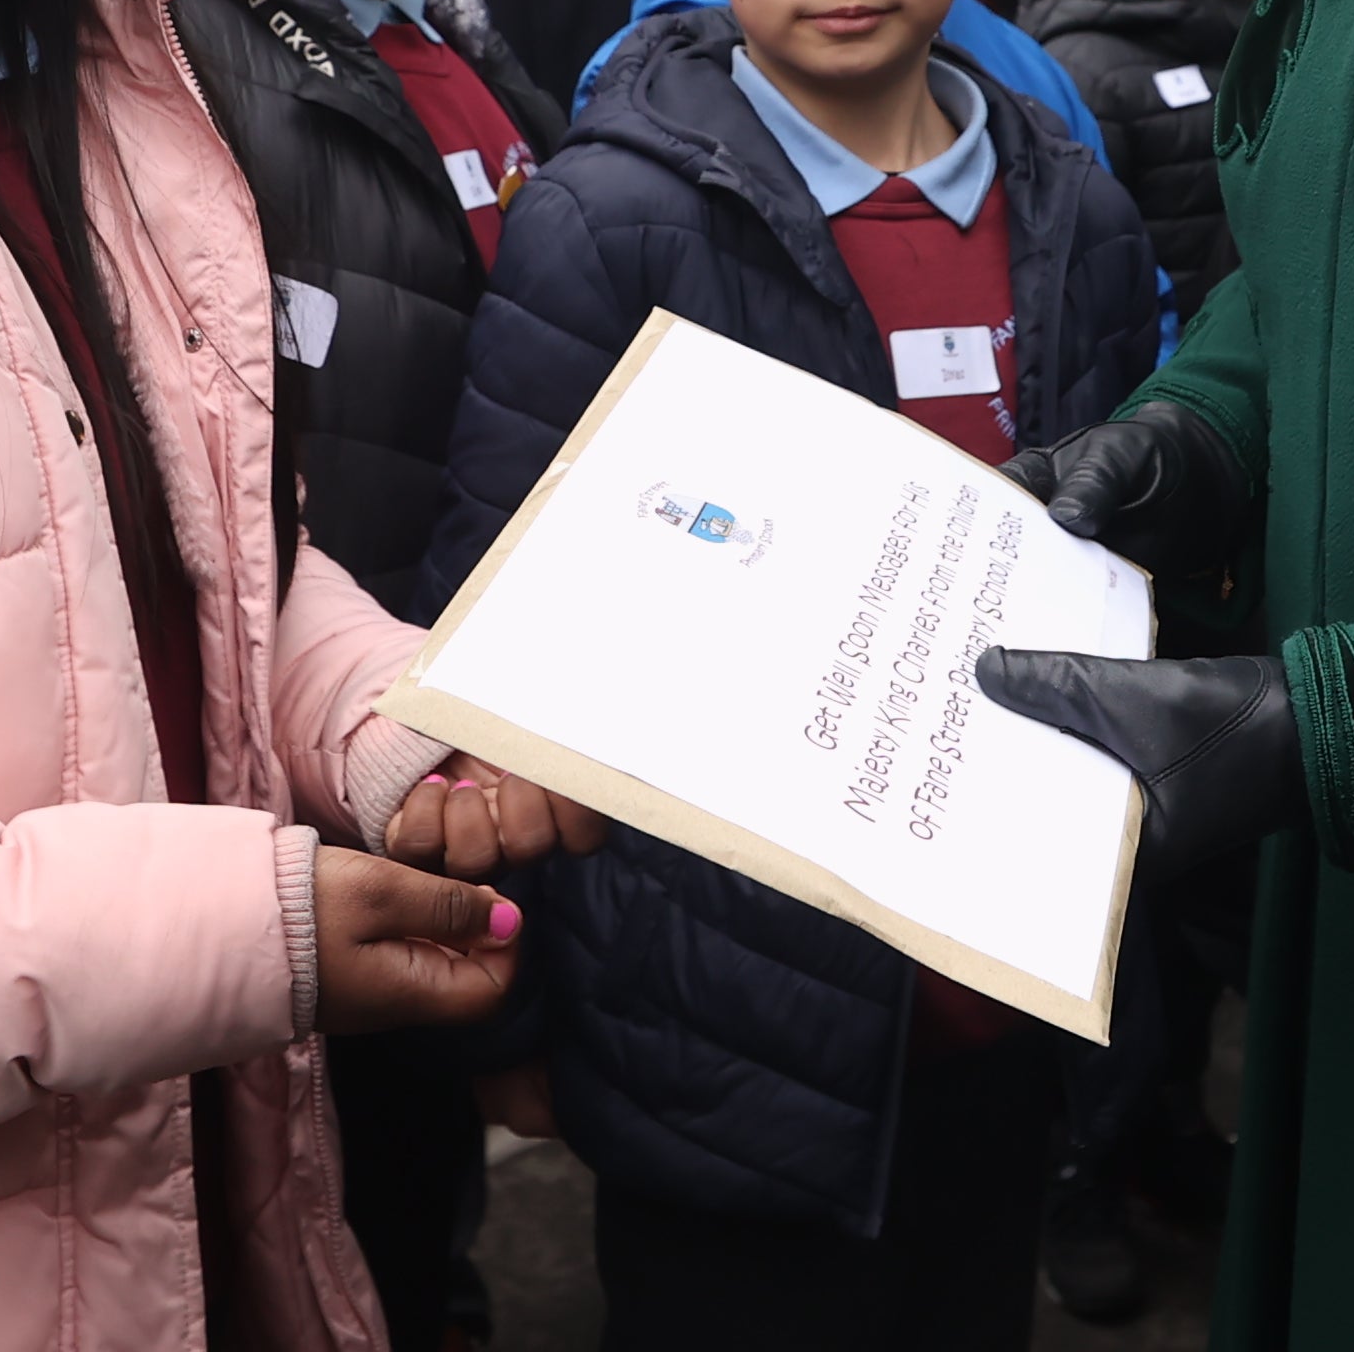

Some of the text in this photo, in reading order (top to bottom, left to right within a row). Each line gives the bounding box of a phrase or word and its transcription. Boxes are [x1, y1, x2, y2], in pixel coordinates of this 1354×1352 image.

[989, 511, 1023, 561] Belfast
[804, 481, 930, 750] Get Well Soon Messages for His
[843, 484, 981, 824] Majesty King Charles from the children
[948, 614, 996, 694] Primary
[929, 690, 971, 764] Street
[914, 755, 952, 813] Fane
[909, 804, 942, 841] of
